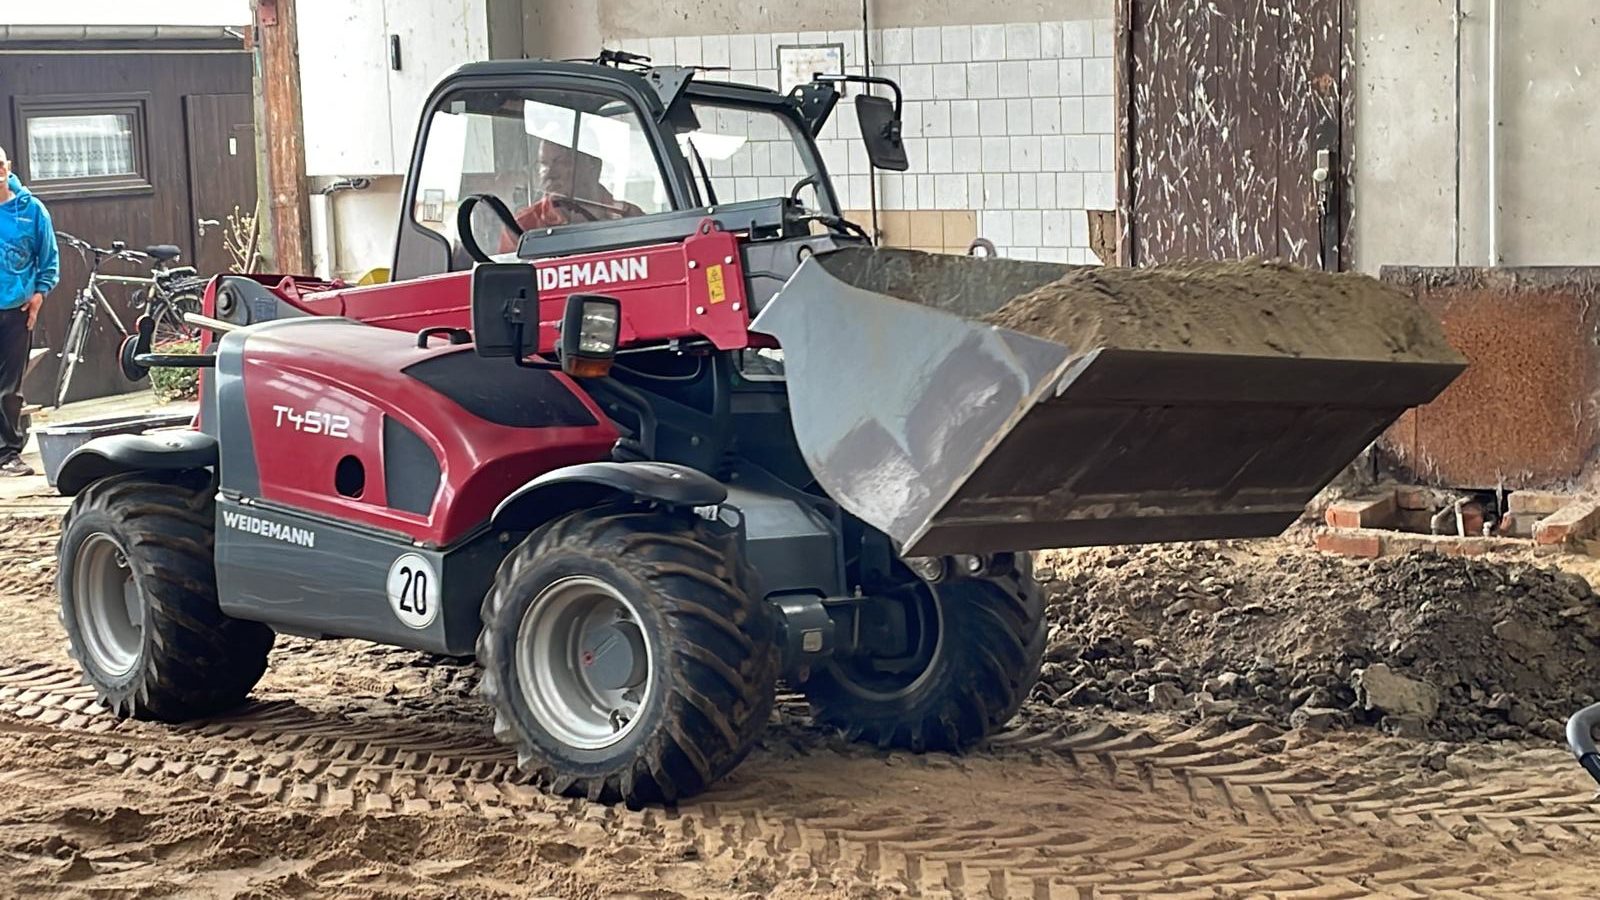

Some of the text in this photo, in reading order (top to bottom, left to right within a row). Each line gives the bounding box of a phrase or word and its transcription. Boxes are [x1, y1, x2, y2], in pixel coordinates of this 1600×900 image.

[536, 256, 649, 291] IDEMANN
[272, 405, 350, 438] T4512
[223, 511, 315, 547] WEIDEMANN
[400, 566, 427, 615] 20
